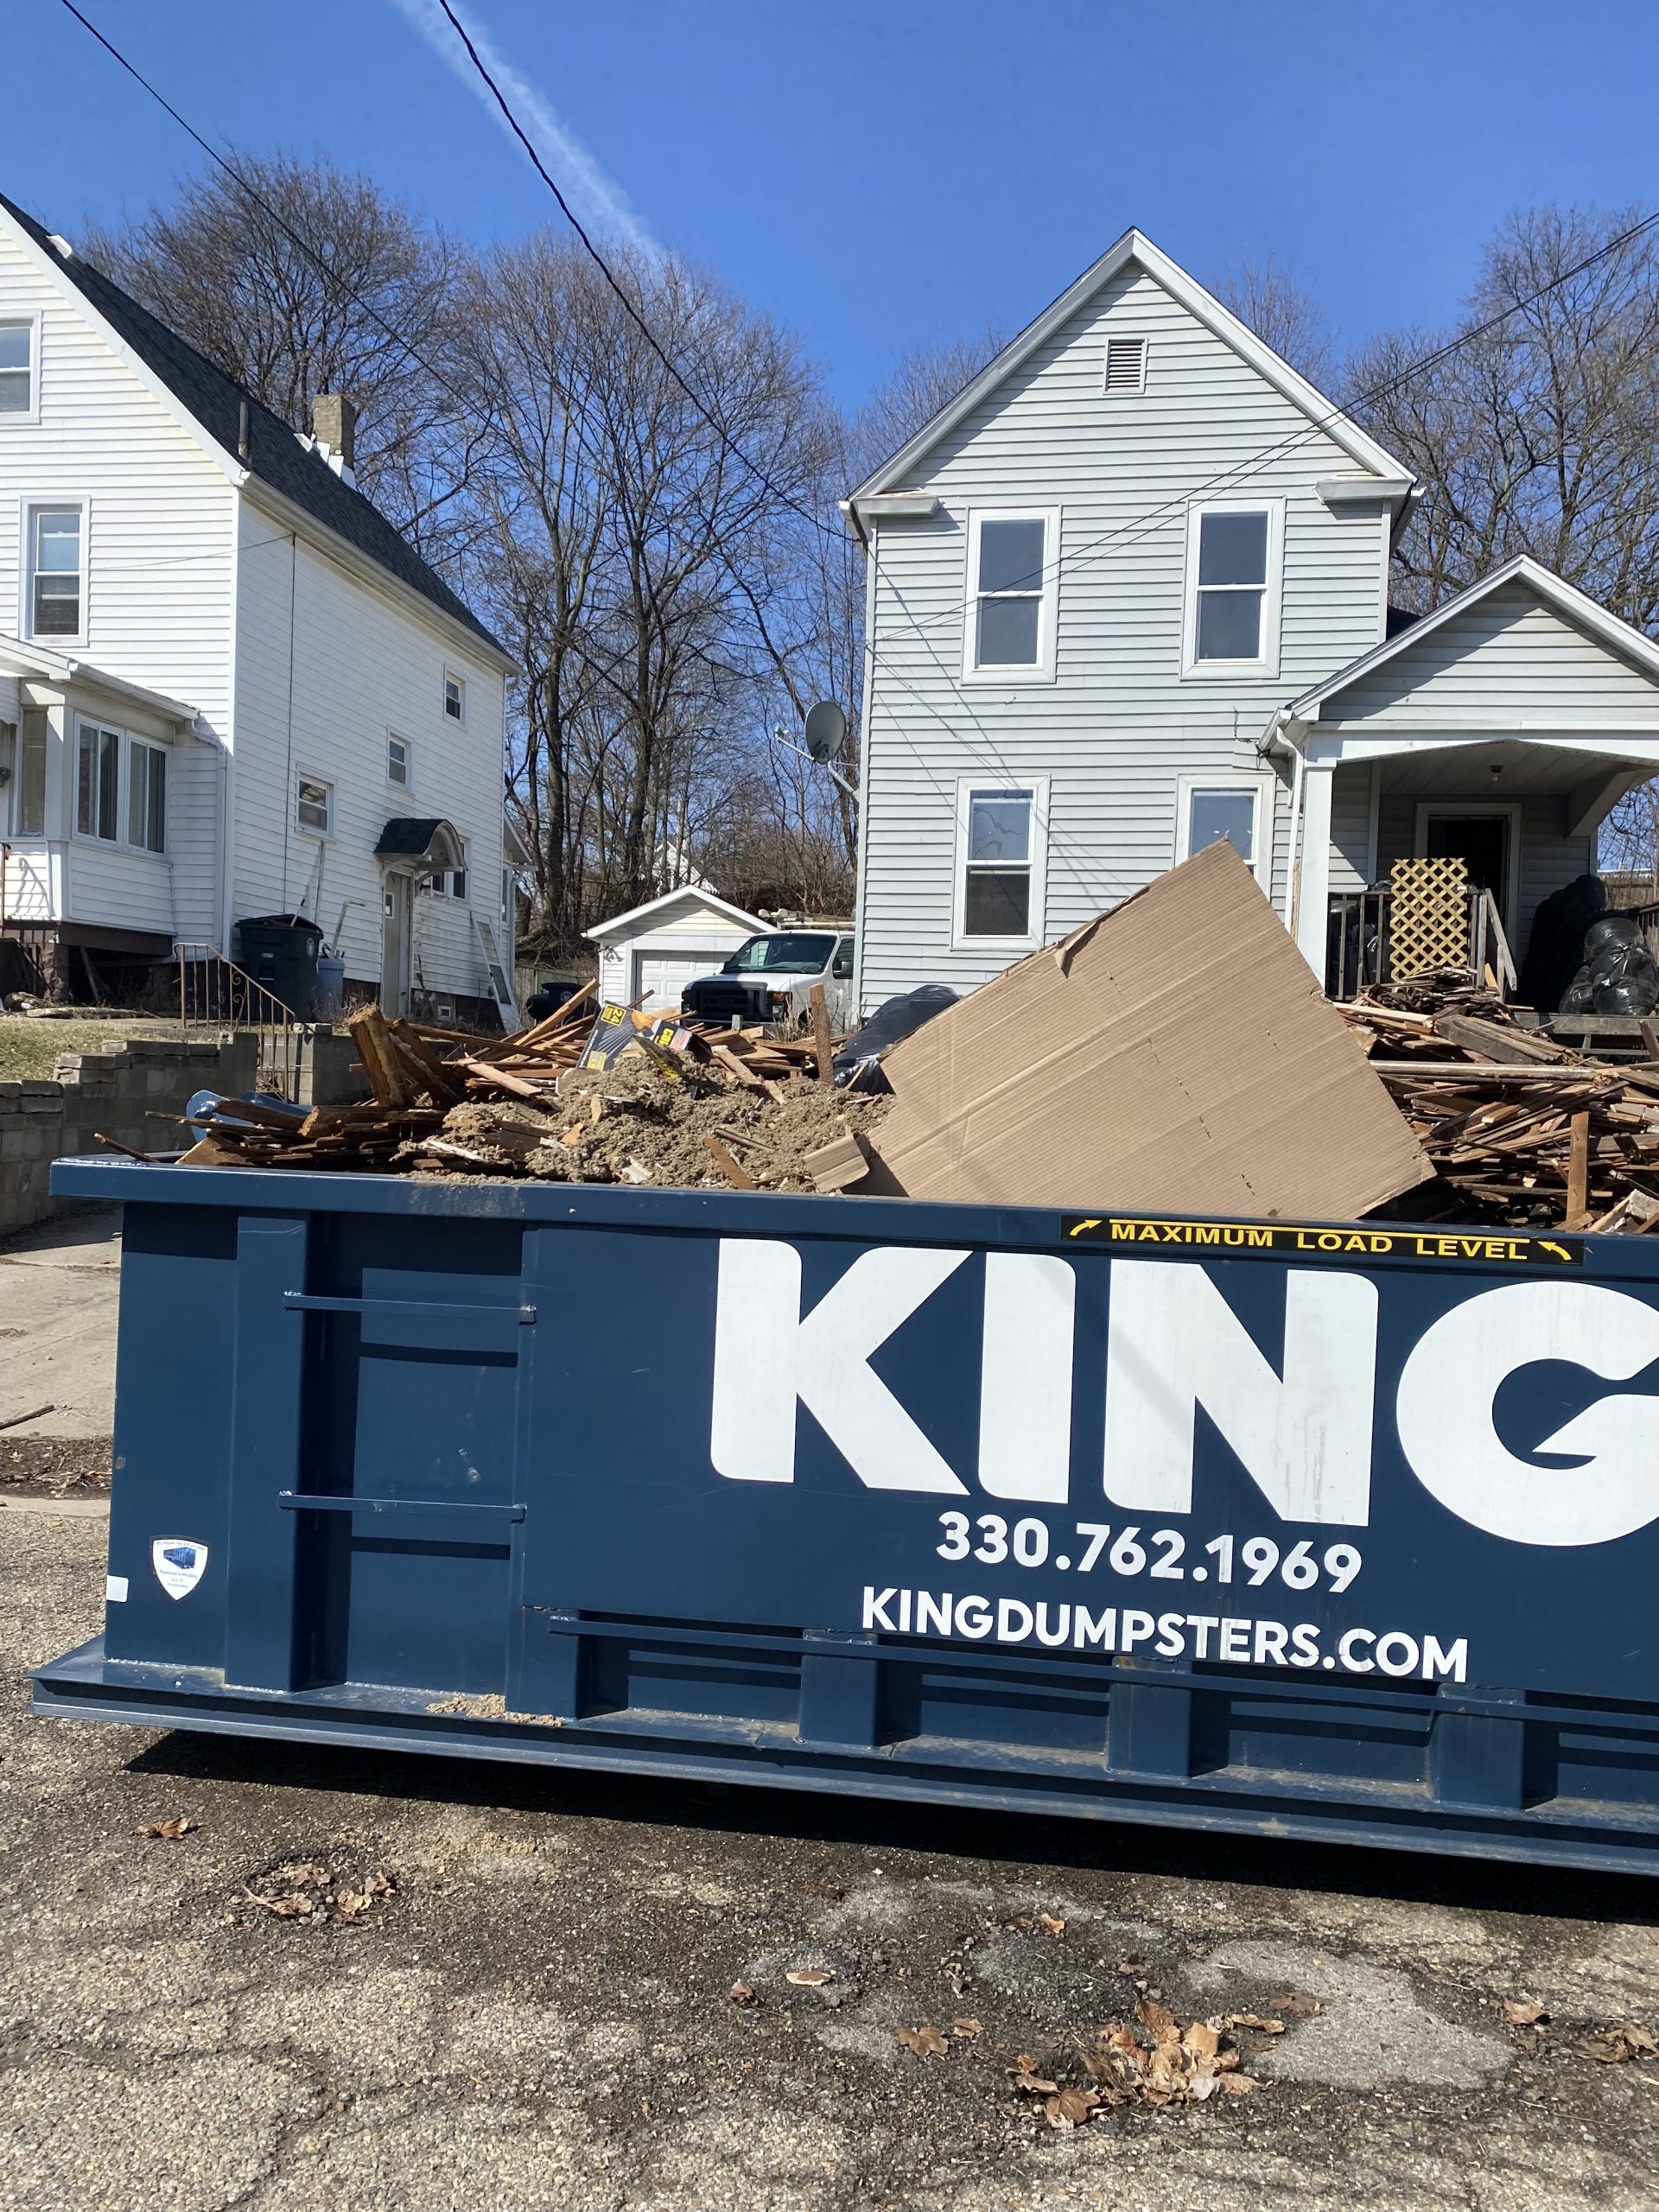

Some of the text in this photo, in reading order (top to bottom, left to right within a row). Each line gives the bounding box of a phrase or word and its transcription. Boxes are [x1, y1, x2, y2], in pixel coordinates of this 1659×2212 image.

[1111, 1223, 1528, 1260] MAXIMUM LOAD LEVEL
[710, 1237, 1659, 1547] KING
[936, 1510, 1363, 1593] 330.762.1969
[861, 1586, 1468, 1684] KINGDUMPSTERS.COM
